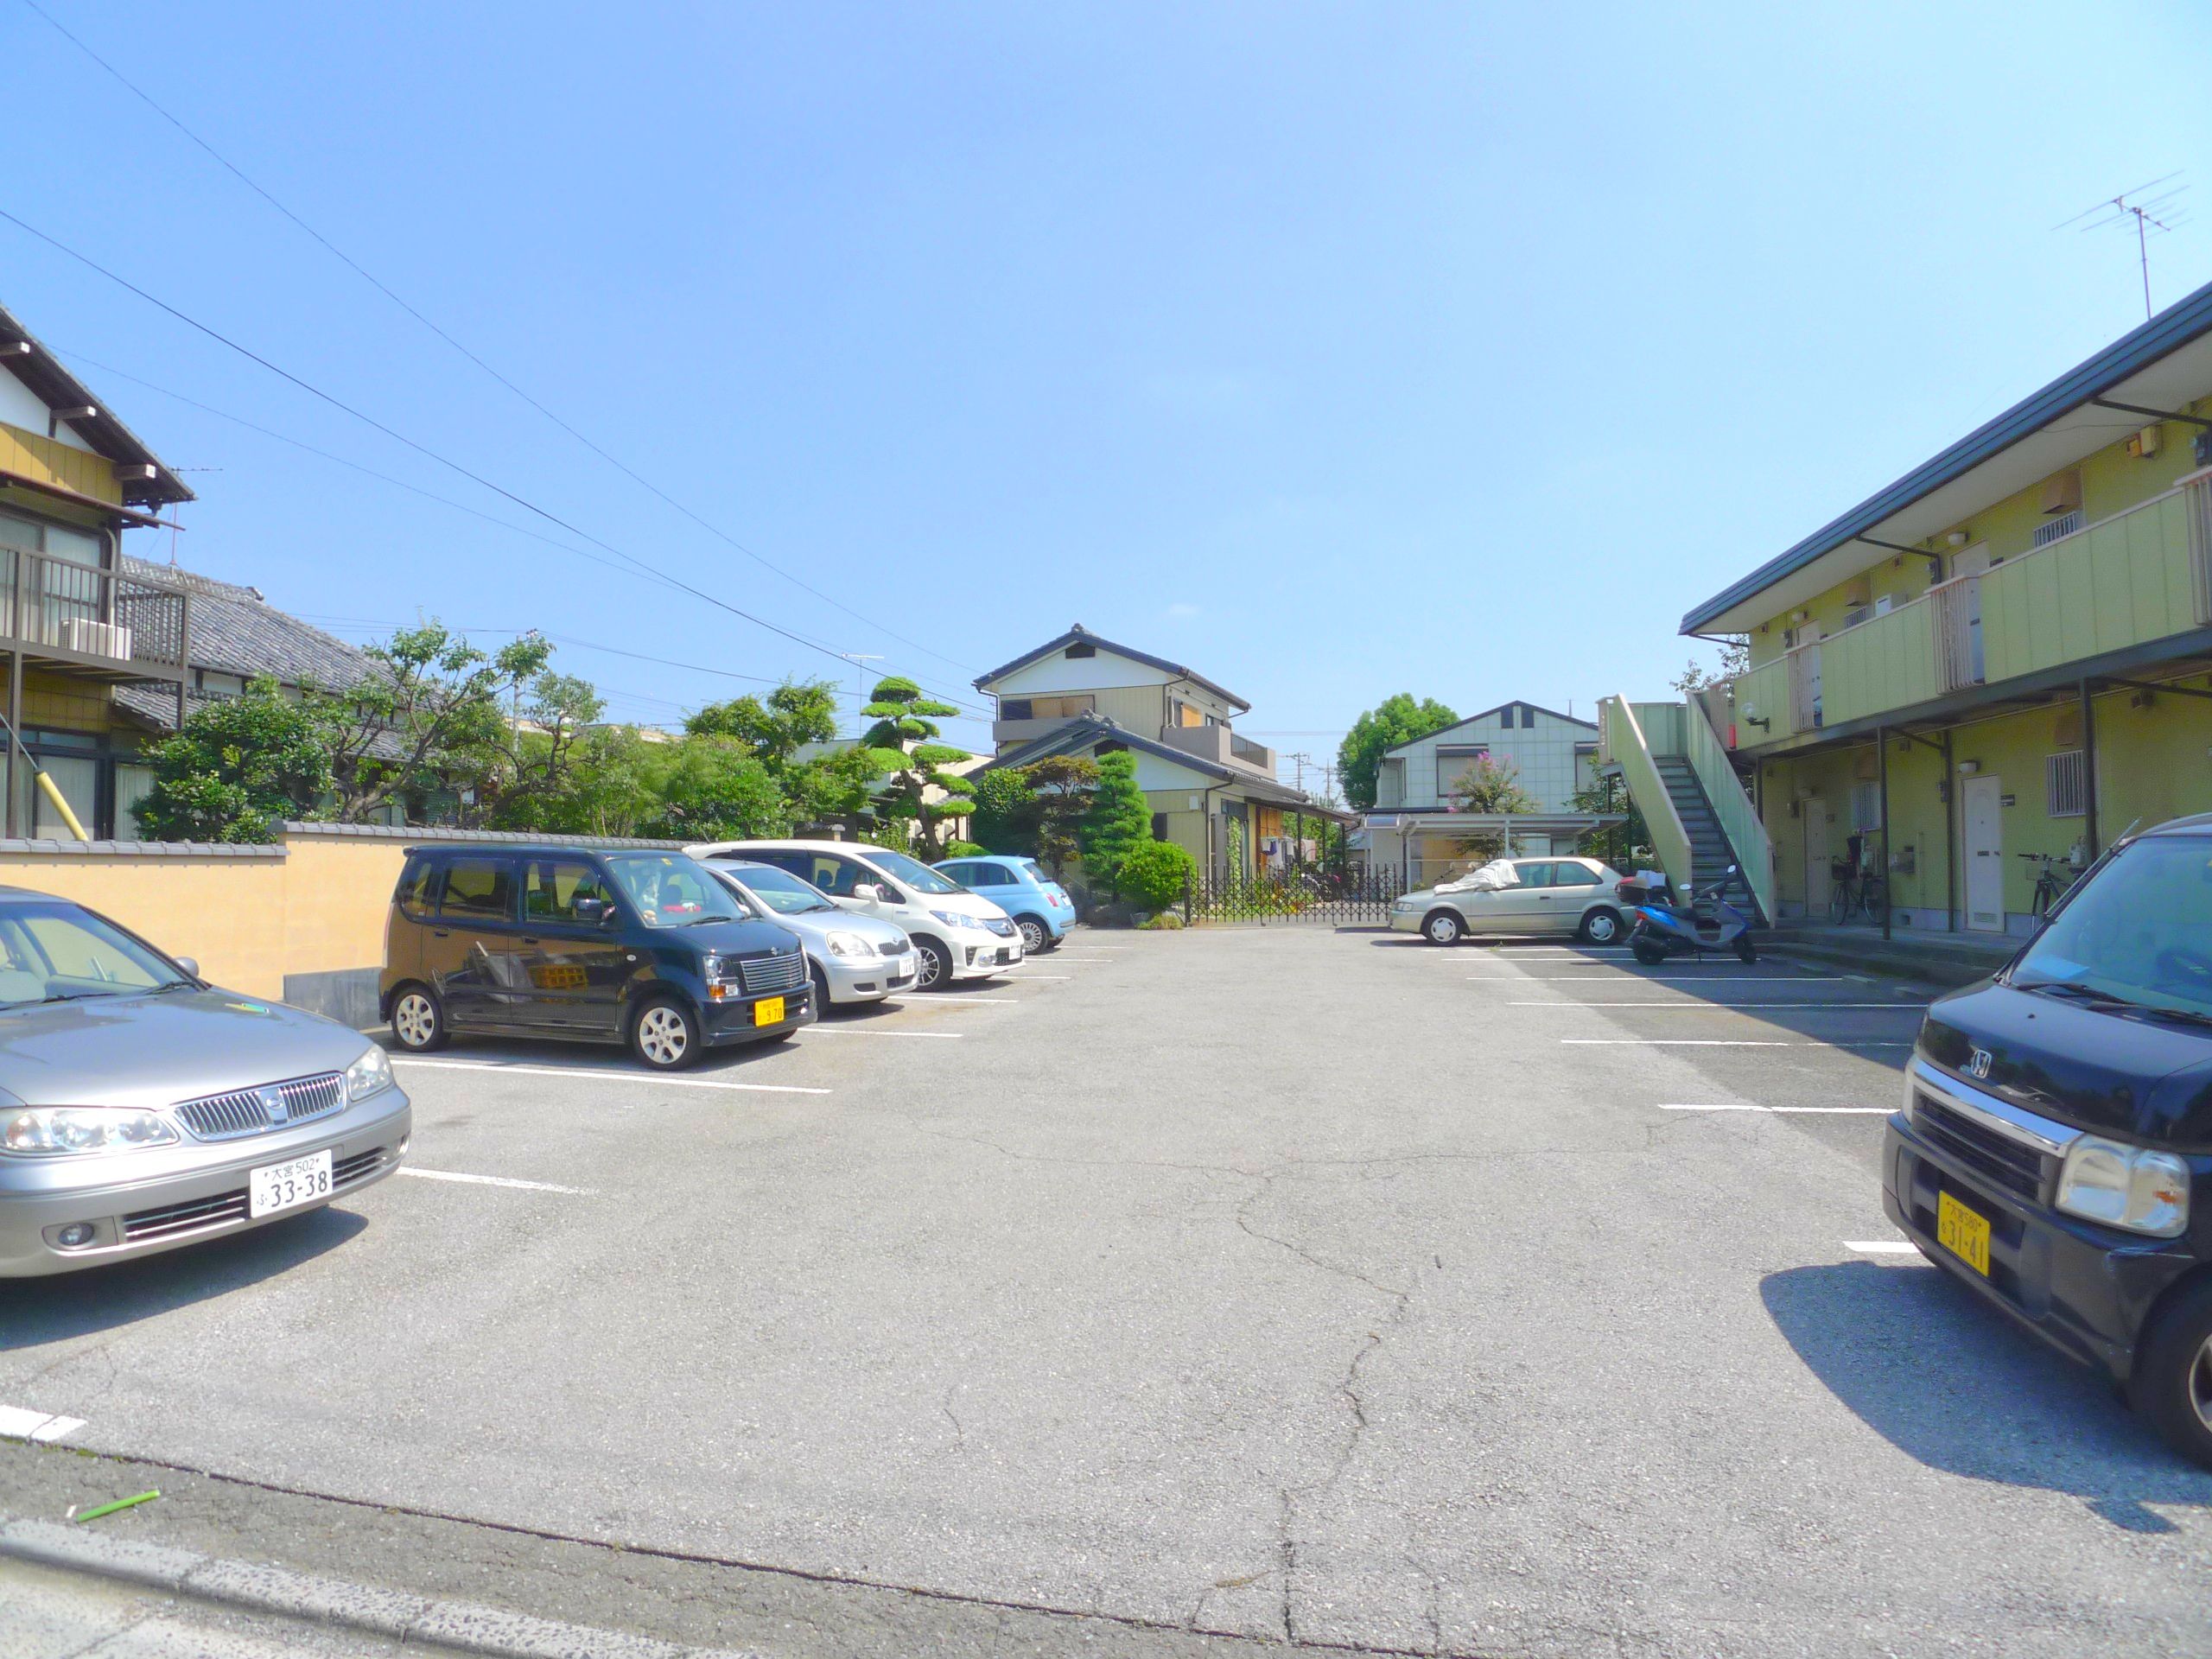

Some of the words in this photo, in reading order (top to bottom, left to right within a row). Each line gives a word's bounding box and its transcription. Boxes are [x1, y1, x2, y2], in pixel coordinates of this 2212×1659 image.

[271, 1164, 295, 1181] 大宮
[296, 1158, 315, 1174] 502
[270, 1170, 327, 1208] 33-38
[1949, 1219, 1985, 1269] 31-41
